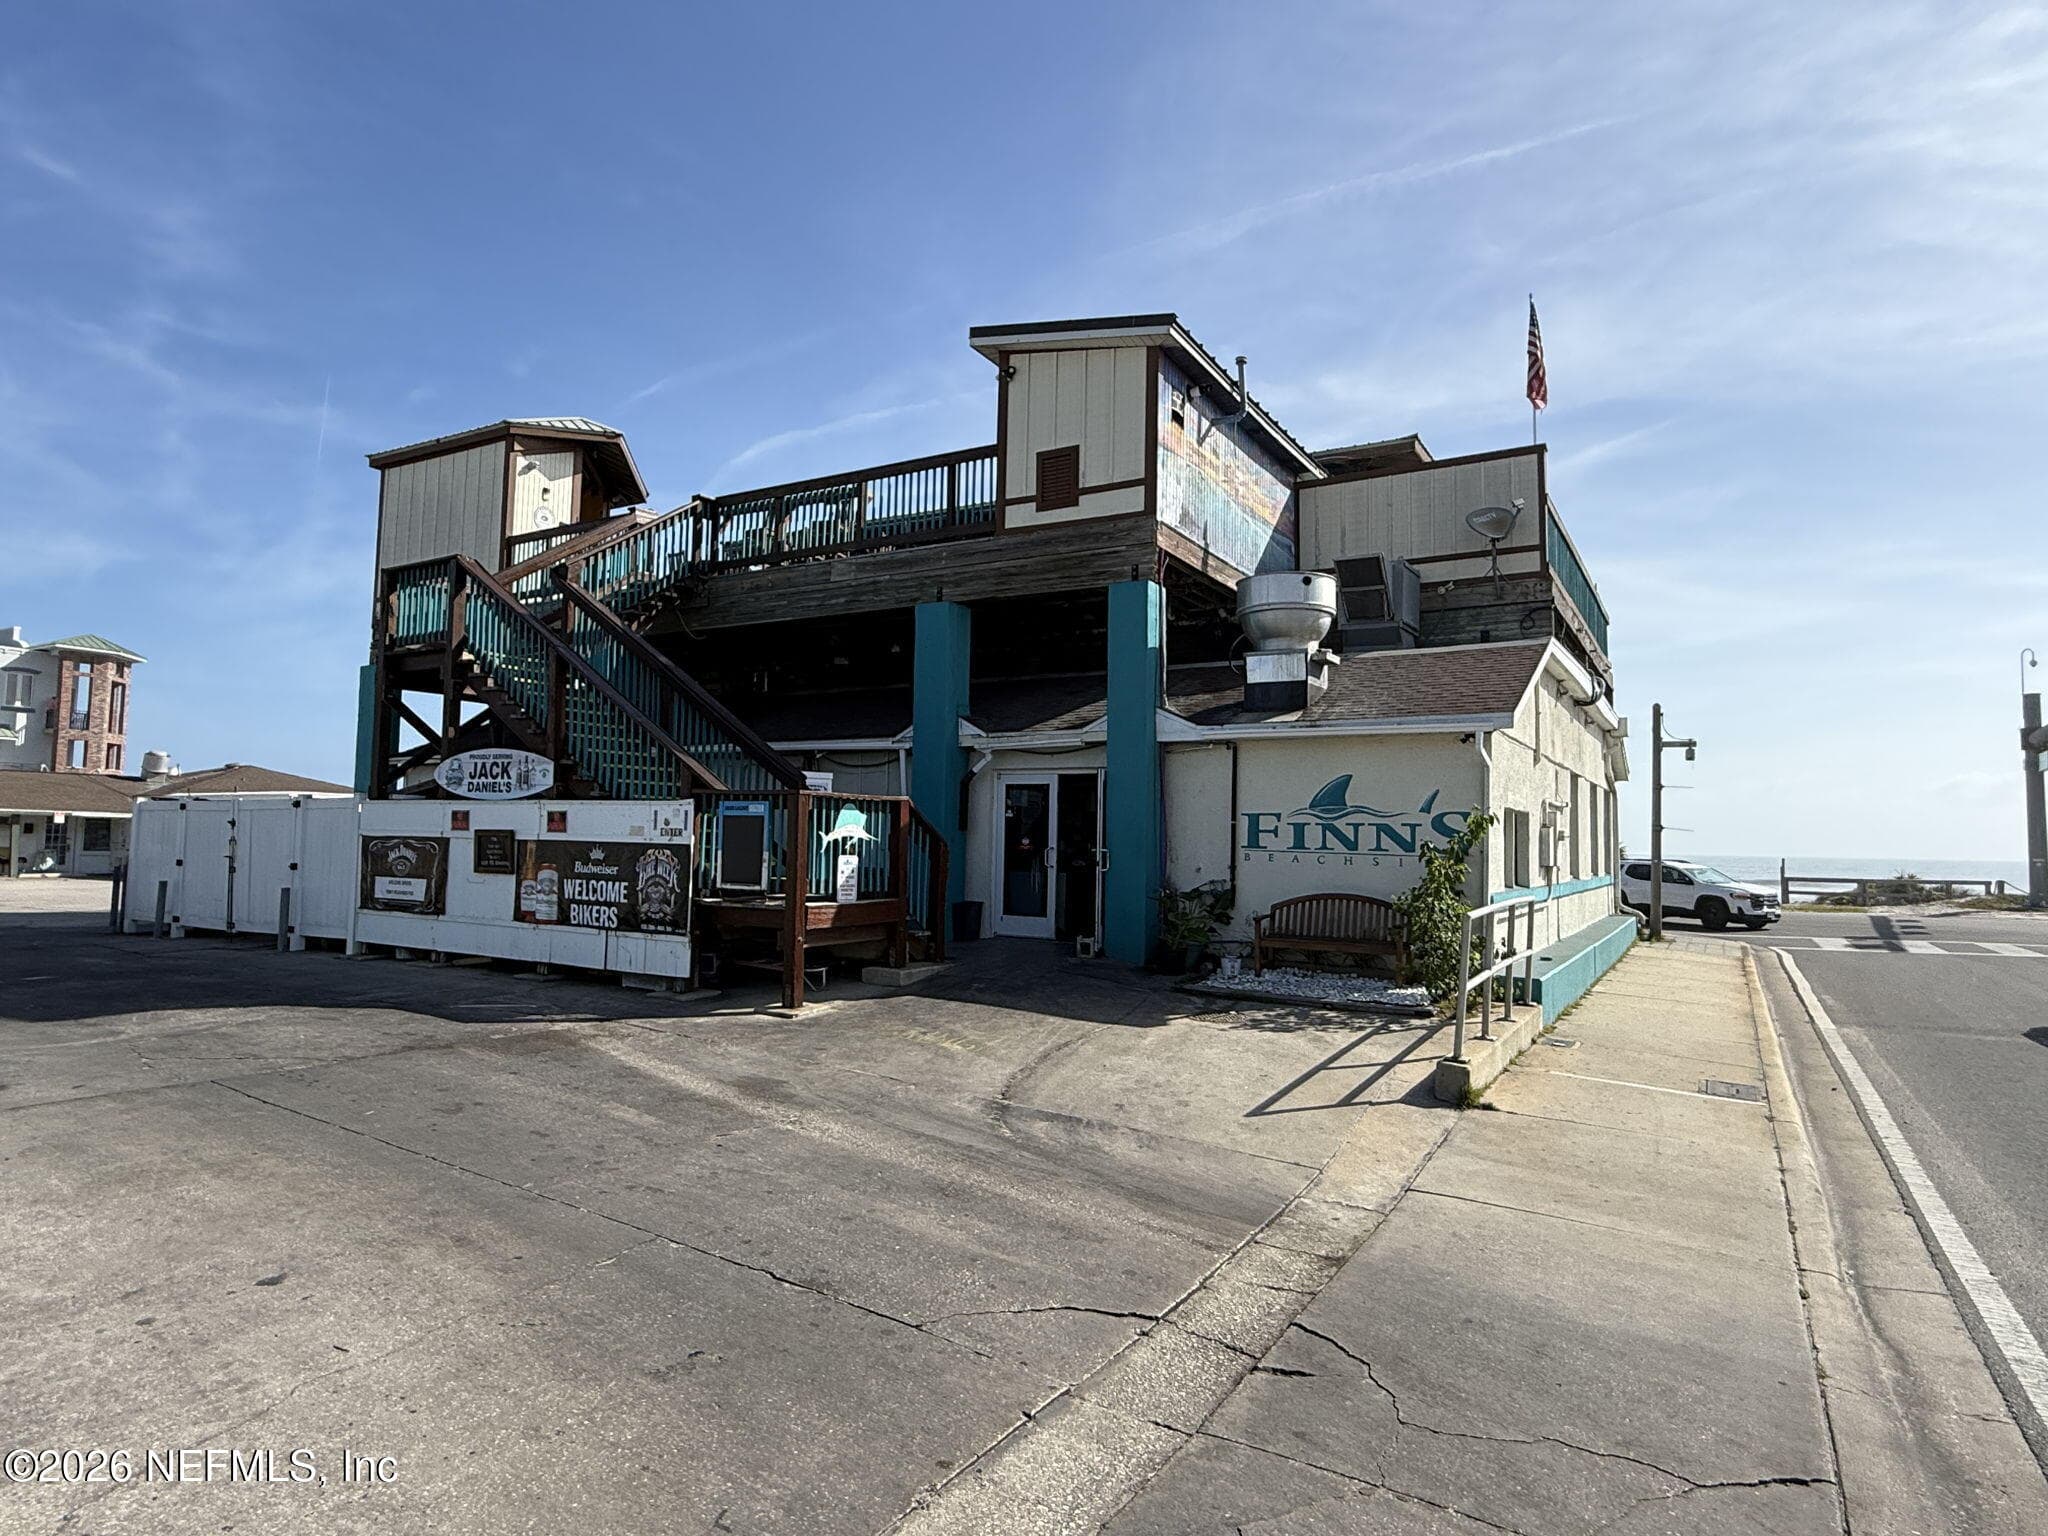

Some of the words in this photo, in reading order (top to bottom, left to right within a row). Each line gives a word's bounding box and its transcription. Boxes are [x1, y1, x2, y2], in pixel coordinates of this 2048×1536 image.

[468, 761, 512, 780] JACK
[467, 781, 512, 794] DANIEL'S
[574, 860, 619, 875] Budweiser
[563, 878, 629, 904] WELCOME
[569, 903, 619, 929] BIKERS
